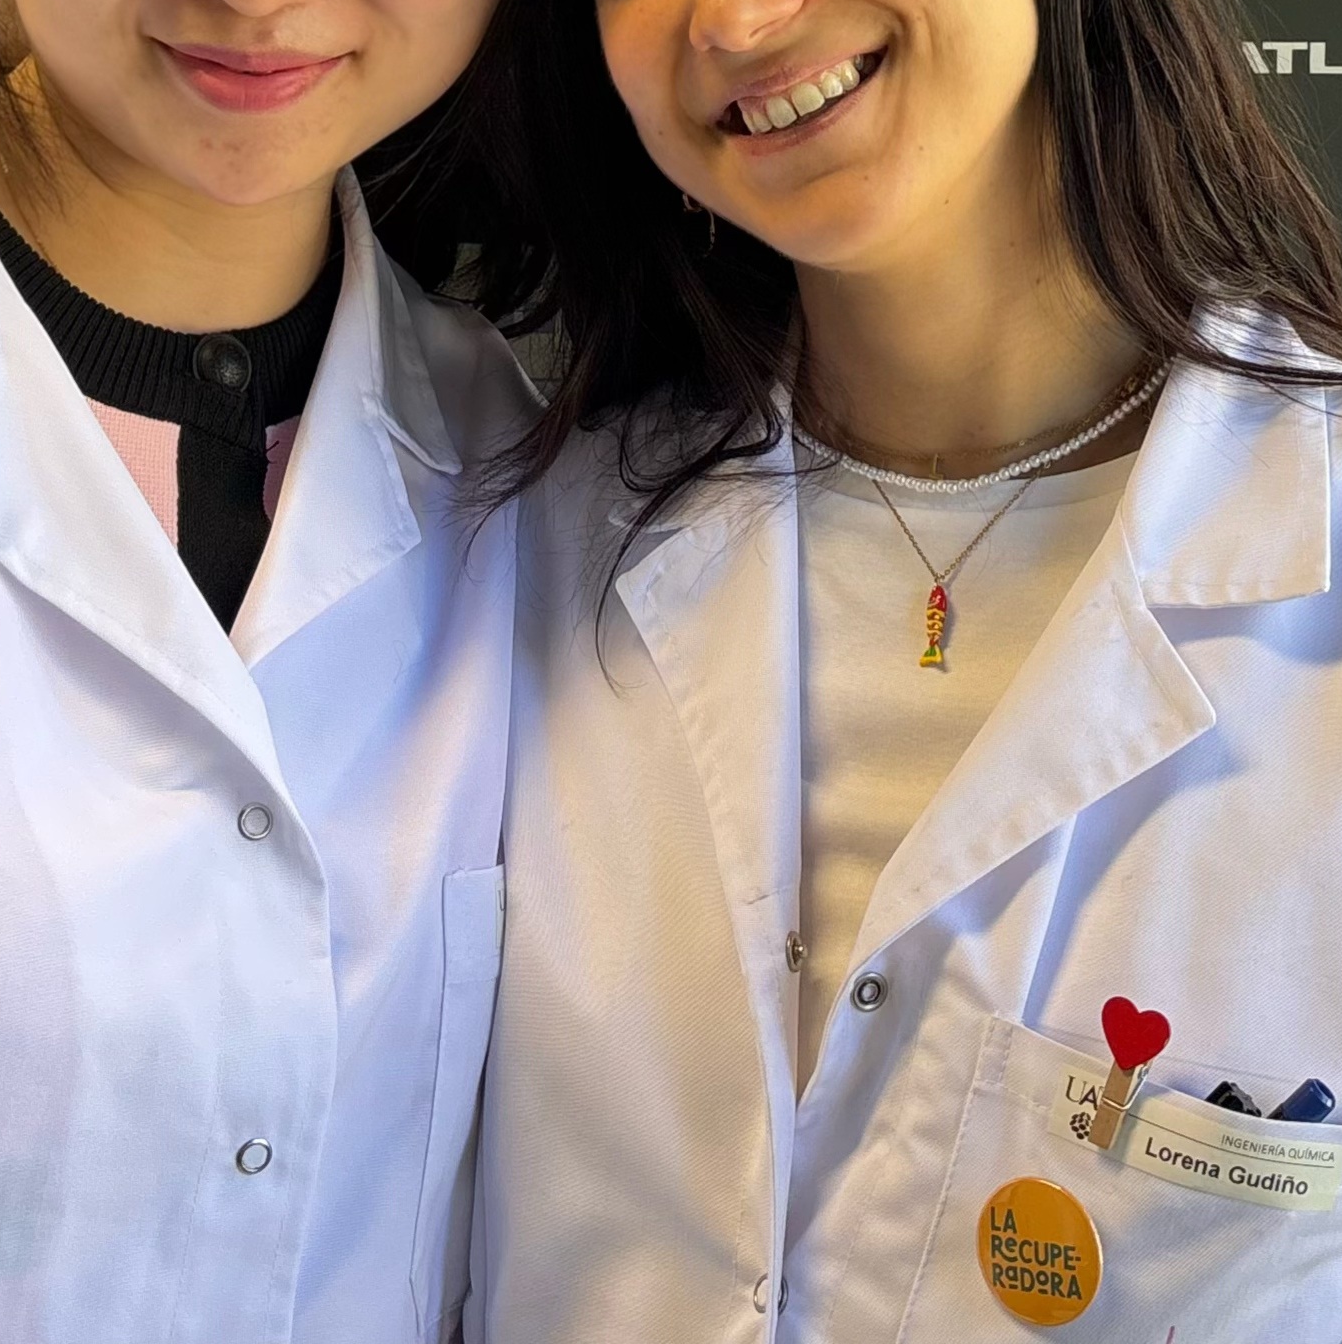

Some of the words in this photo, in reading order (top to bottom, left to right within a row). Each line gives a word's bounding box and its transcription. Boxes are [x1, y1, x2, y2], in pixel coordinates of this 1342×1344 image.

[1065, 1074, 1106, 1111] UA
[1221, 1133, 1286, 1158] INGENIERÍA
[1287, 1144, 1336, 1164] QUÍMICA
[1144, 1136, 1221, 1180] Lorena
[1227, 1164, 1309, 1196] Gudiño
[990, 1205, 1018, 1234] LA
